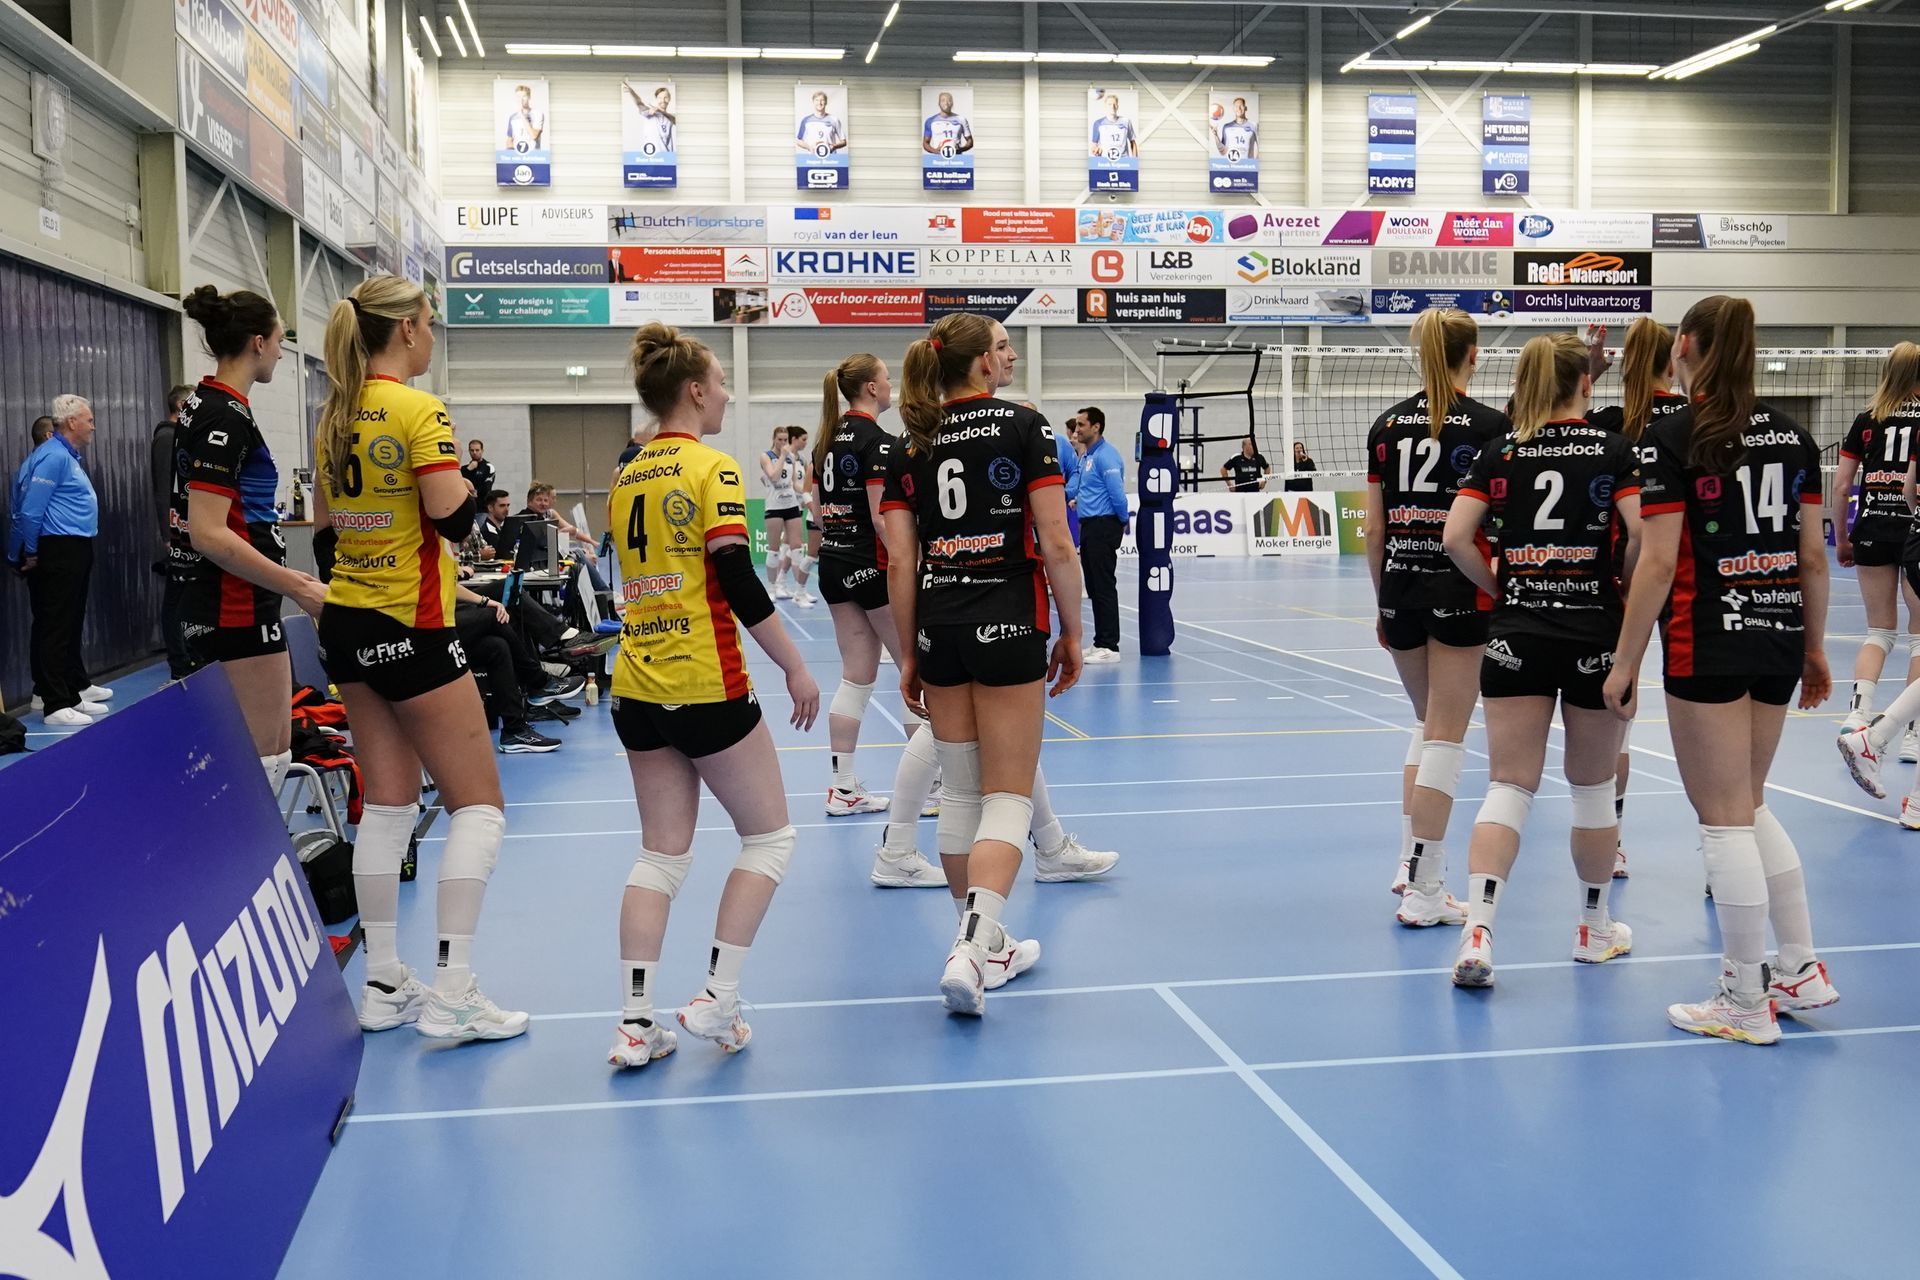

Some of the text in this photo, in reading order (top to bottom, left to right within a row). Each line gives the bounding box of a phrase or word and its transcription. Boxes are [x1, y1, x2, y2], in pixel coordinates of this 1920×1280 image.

[191, 0, 245, 77] Rabobank
[1484, 124, 1528, 134] HETEREN
[207, 115, 233, 159] VISSER
[943, 147, 953, 157] 11
[1109, 149, 1119, 159] 12
[1229, 150, 1239, 161] 14
[1370, 177, 1414, 188] FLORYS
[458, 207, 519, 230] EQUIPE
[542, 208, 594, 219] ADVISEURS
[1156, 210, 1184, 221] ALLES
[1264, 213, 1320, 227] Avezet
[1131, 220, 1185, 235] WAT JE KAN
[1187, 219, 1211, 237] Jan
[1390, 218, 1429, 226] WOON
[1453, 218, 1503, 228] méér dan
[794, 230, 821, 242] royal
[849, 230, 869, 240] der
[872, 230, 898, 240] leun
[1453, 228, 1489, 237] wonen
[1707, 234, 1785, 247] Technische Projecten
[643, 248, 721, 256] Personeelshuisvesting
[930, 249, 1072, 263] KOPPELAAR
[777, 251, 915, 273] KROHNE
[1151, 251, 1193, 269] L&B
[1272, 258, 1360, 275] Blokland
[1389, 251, 1497, 275] BANKIE
[476, 259, 604, 275] letselschade.com
[727, 269, 764, 277] Homeflex.nl
[929, 268, 1072, 276] notarissen
[1528, 262, 1637, 284] ReGi Watersport
[1150, 272, 1212, 282] Verzekeringen
[518, 298, 544, 306] design
[929, 295, 1018, 304] Thuis in Sliedrecht
[1090, 293, 1105, 312] R
[1116, 292, 1186, 303] huis aan huis
[1525, 294, 1641, 310] Orchis uitvaartzorg
[514, 307, 553, 315] challenge
[1116, 306, 1182, 319] verspreiding
[1531, 316, 1636, 324] www.orchisuitvaartzorg.nl
[1397, 413, 1472, 427] salesock
[1534, 426, 1608, 438] De Vosse
[1517, 443, 1605, 457] salesdock
[1884, 426, 1912, 462] 11
[823, 451, 834, 492] 8
[1397, 437, 1441, 493] 12
[618, 463, 683, 488] salesdock
[373, 485, 413, 494] Groupwise
[936, 458, 967, 520] 6
[1533, 470, 1565, 530] 2
[1736, 462, 1788, 535] 14
[627, 494, 648, 563] 4
[665, 545, 702, 555] Groupwise
[1255, 538, 1332, 549] Moker Energie
[1504, 543, 1598, 567] autohopper
[966, 557, 1004, 567] shortlease
[933, 575, 958, 584] GHALA
[1744, 617, 1772, 628] GHALA
[261, 622, 281, 643] 13
[377, 638, 414, 659] Firat
[448, 640, 467, 668] 15
